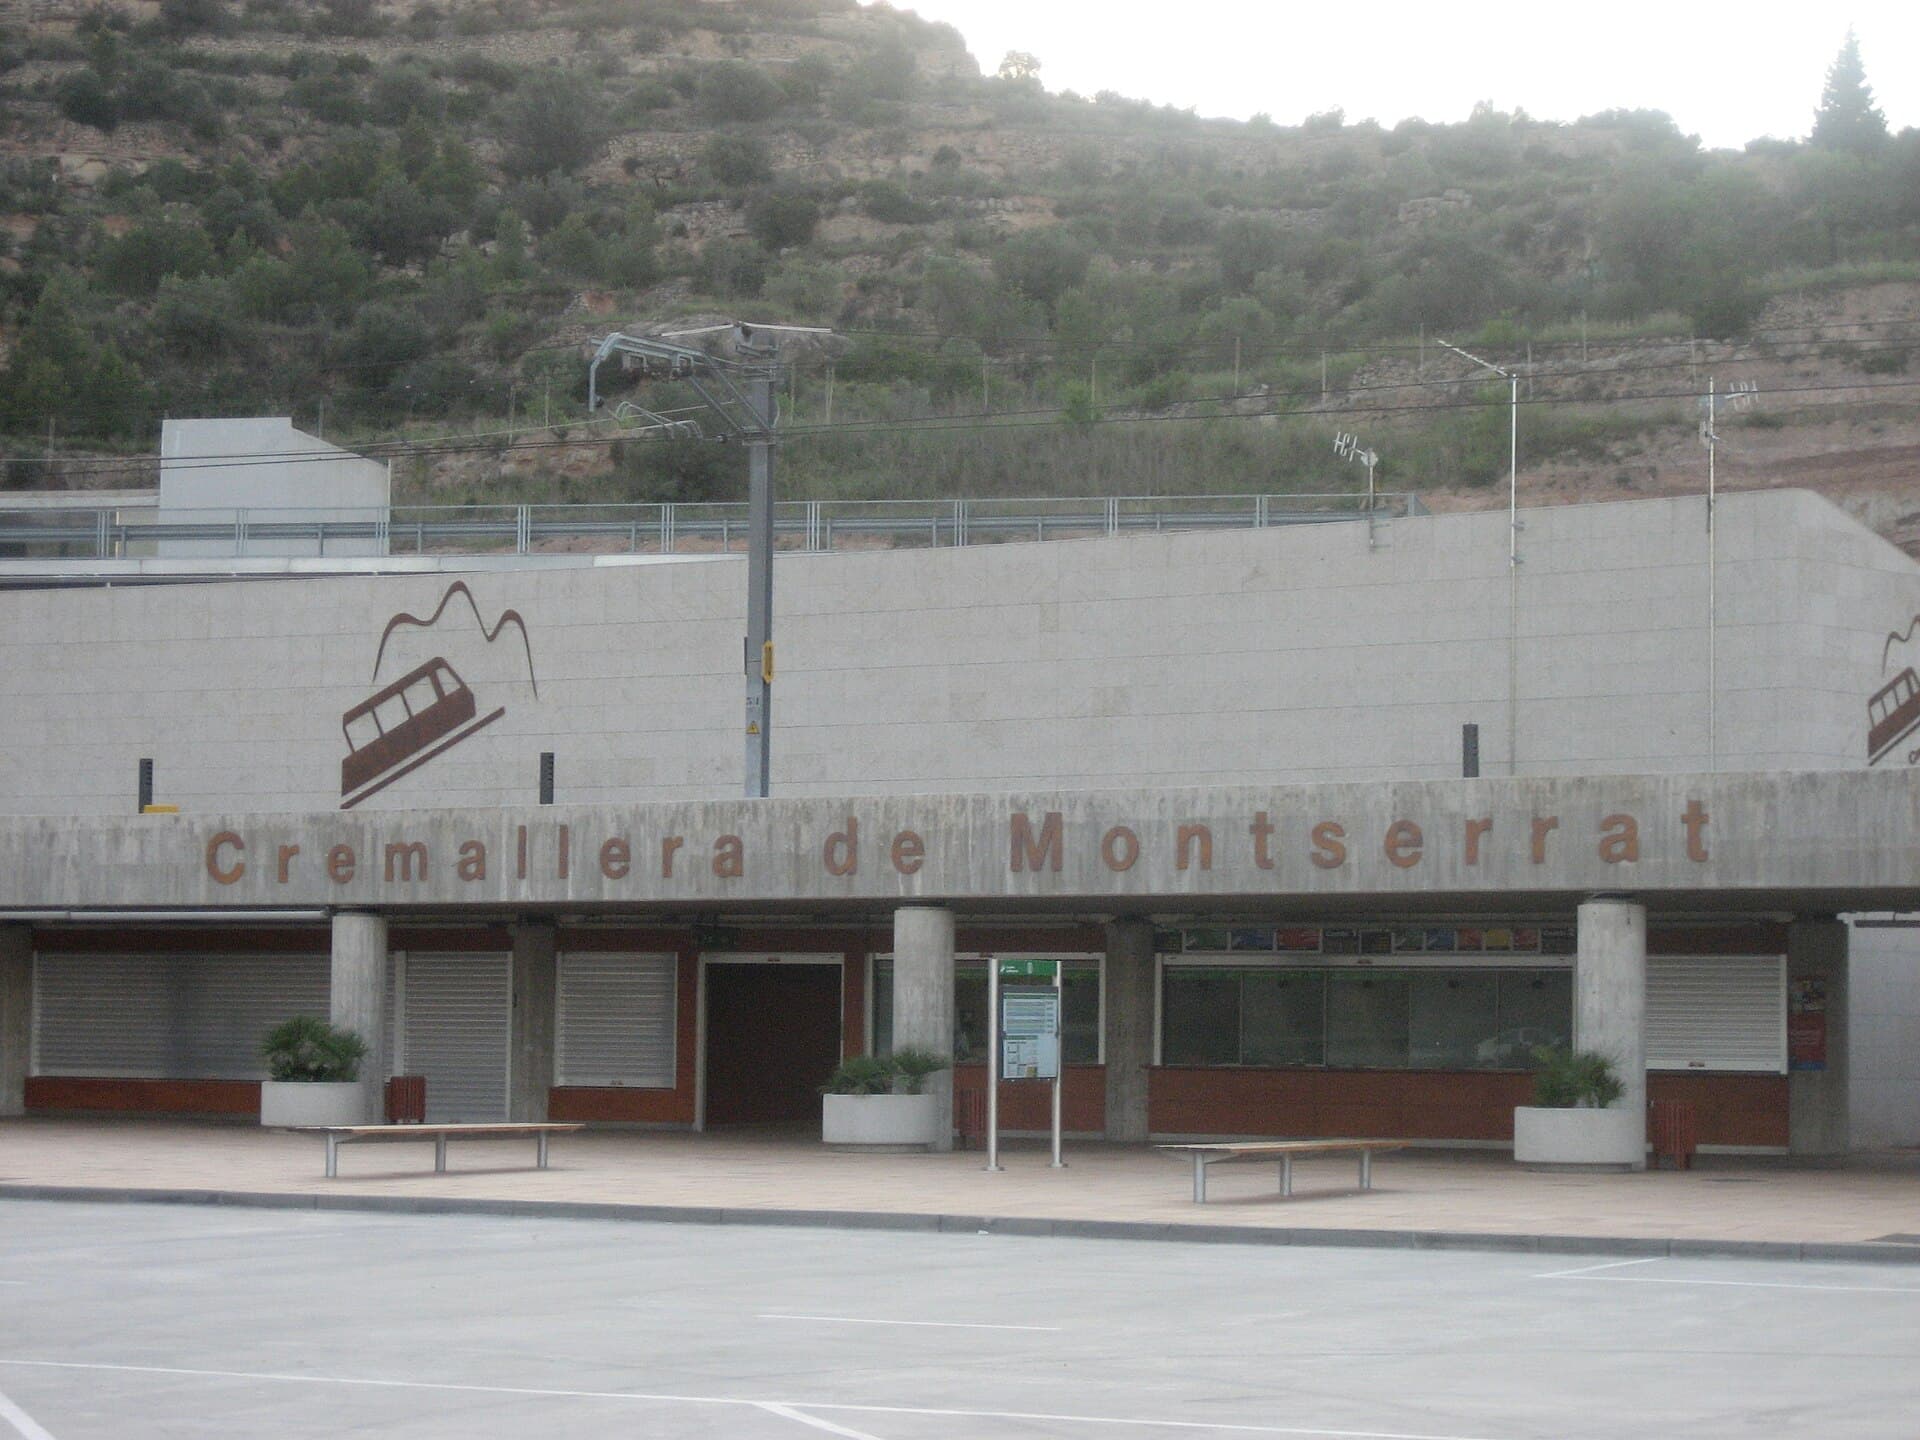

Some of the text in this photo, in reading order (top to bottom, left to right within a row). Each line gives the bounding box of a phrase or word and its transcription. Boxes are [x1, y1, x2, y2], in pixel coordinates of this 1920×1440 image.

[206, 800, 1710, 884] Cremallera de Montserrat
